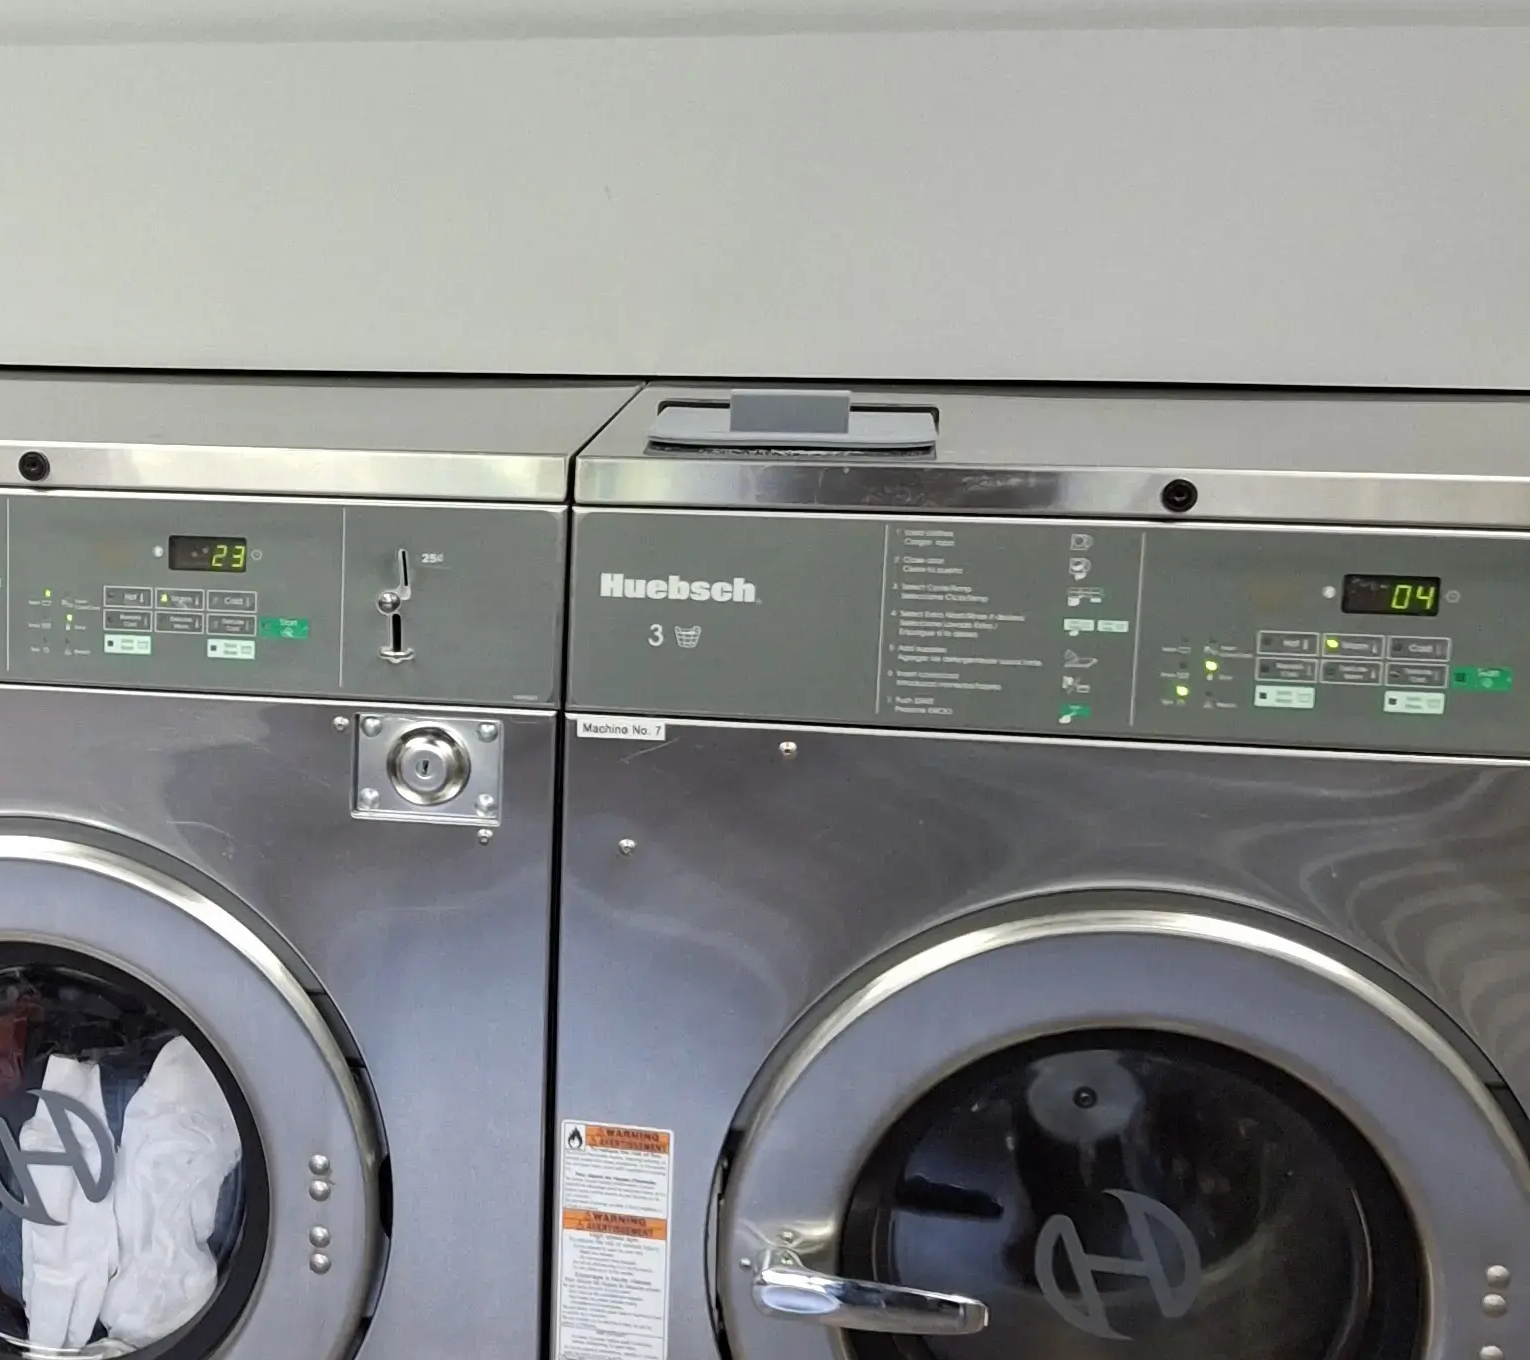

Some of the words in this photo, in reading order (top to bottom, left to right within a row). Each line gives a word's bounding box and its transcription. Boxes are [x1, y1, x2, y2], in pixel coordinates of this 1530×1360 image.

[211, 544, 246, 570] 23
[600, 573, 757, 604] Huebsch
[1390, 583, 1436, 611] 04
[647, 624, 664, 647] 3
[582, 722, 629, 735] Machine
[655, 725, 662, 736] 7
[605, 1128, 660, 1142] WARNING
[591, 1211, 647, 1226] WARNING
